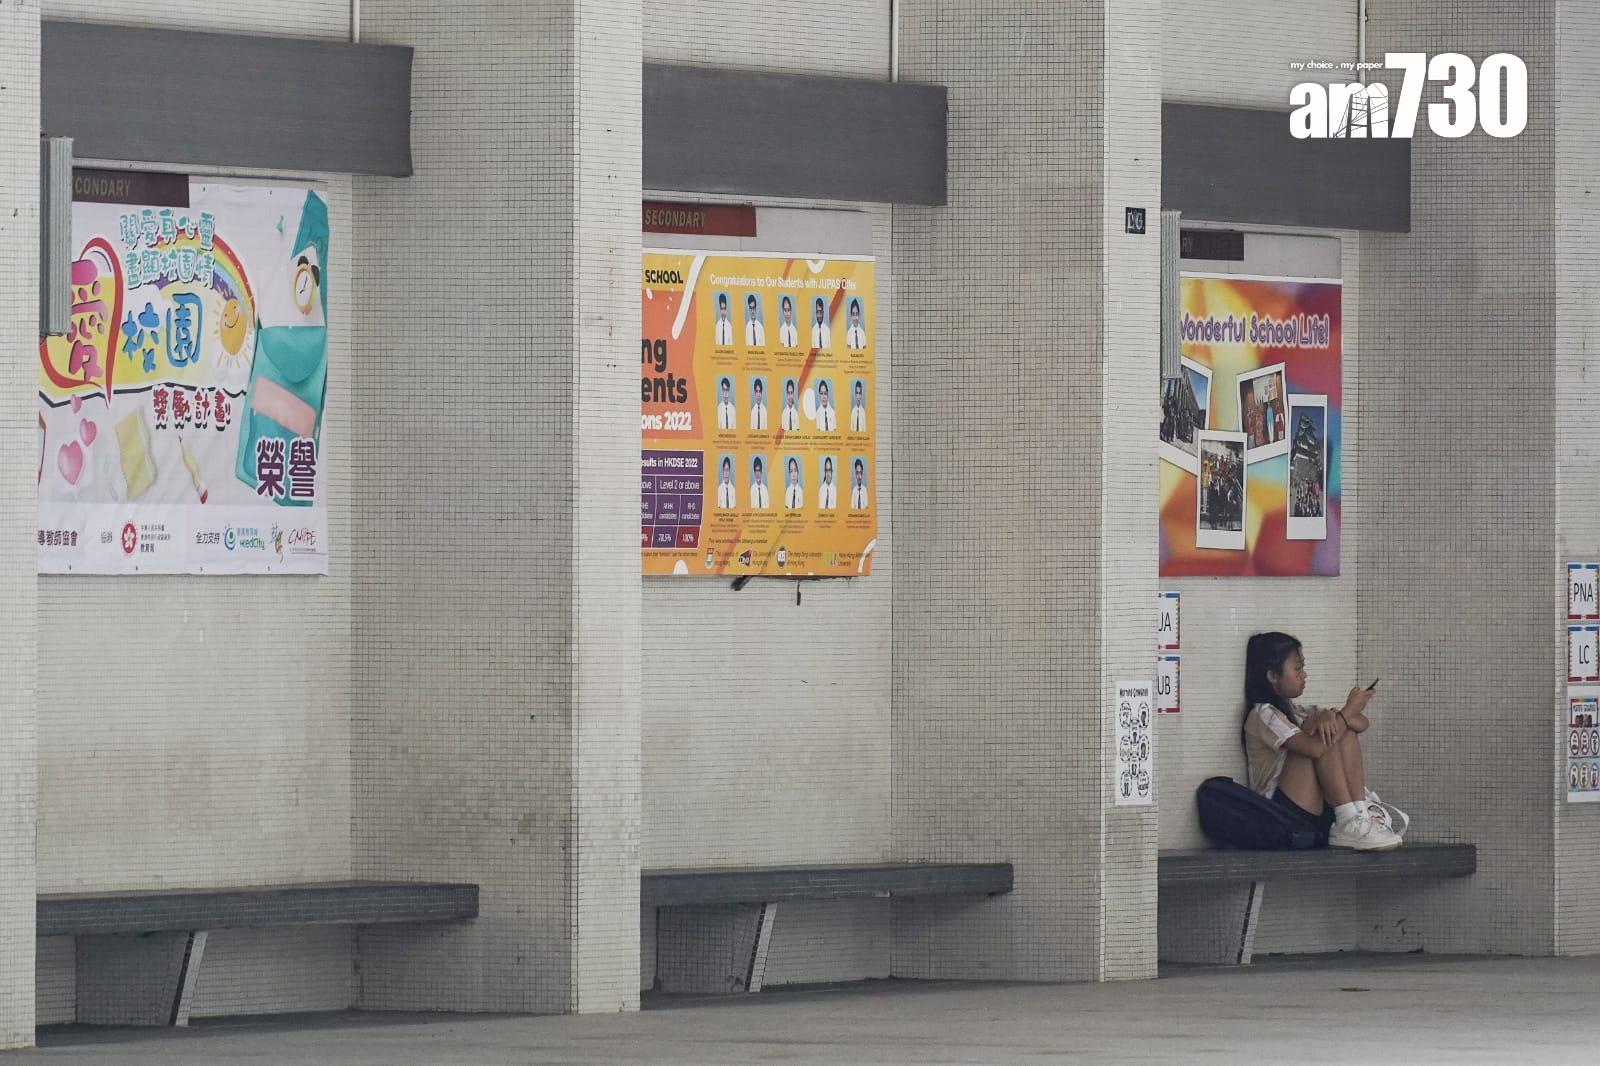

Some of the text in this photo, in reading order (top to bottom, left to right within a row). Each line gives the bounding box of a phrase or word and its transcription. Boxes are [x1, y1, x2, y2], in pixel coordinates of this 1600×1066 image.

[645, 209, 706, 228] SECONDARY
[645, 269, 684, 284] SCHOOL
[710, 273, 756, 288] Congratulations
[757, 276, 765, 286] to
[765, 276, 777, 287] Our
[777, 276, 804, 289] Students
[805, 278, 817, 289] with
[818, 278, 840, 290] JUPAS
[121, 292, 204, 374] 校園
[1250, 314, 1297, 344] School
[642, 372, 688, 404] ents
[641, 410, 692, 431] ons 2022
[256, 440, 317, 498] 榮譽
[658, 457, 664, 467] in
[664, 457, 684, 468] HKDSE
[685, 458, 698, 468] 2022
[660, 480, 673, 490] Level
[684, 480, 700, 490] above
[1573, 582, 1594, 602] PNA
[1579, 644, 1590, 665] LC
[1157, 675, 1171, 695] UB
